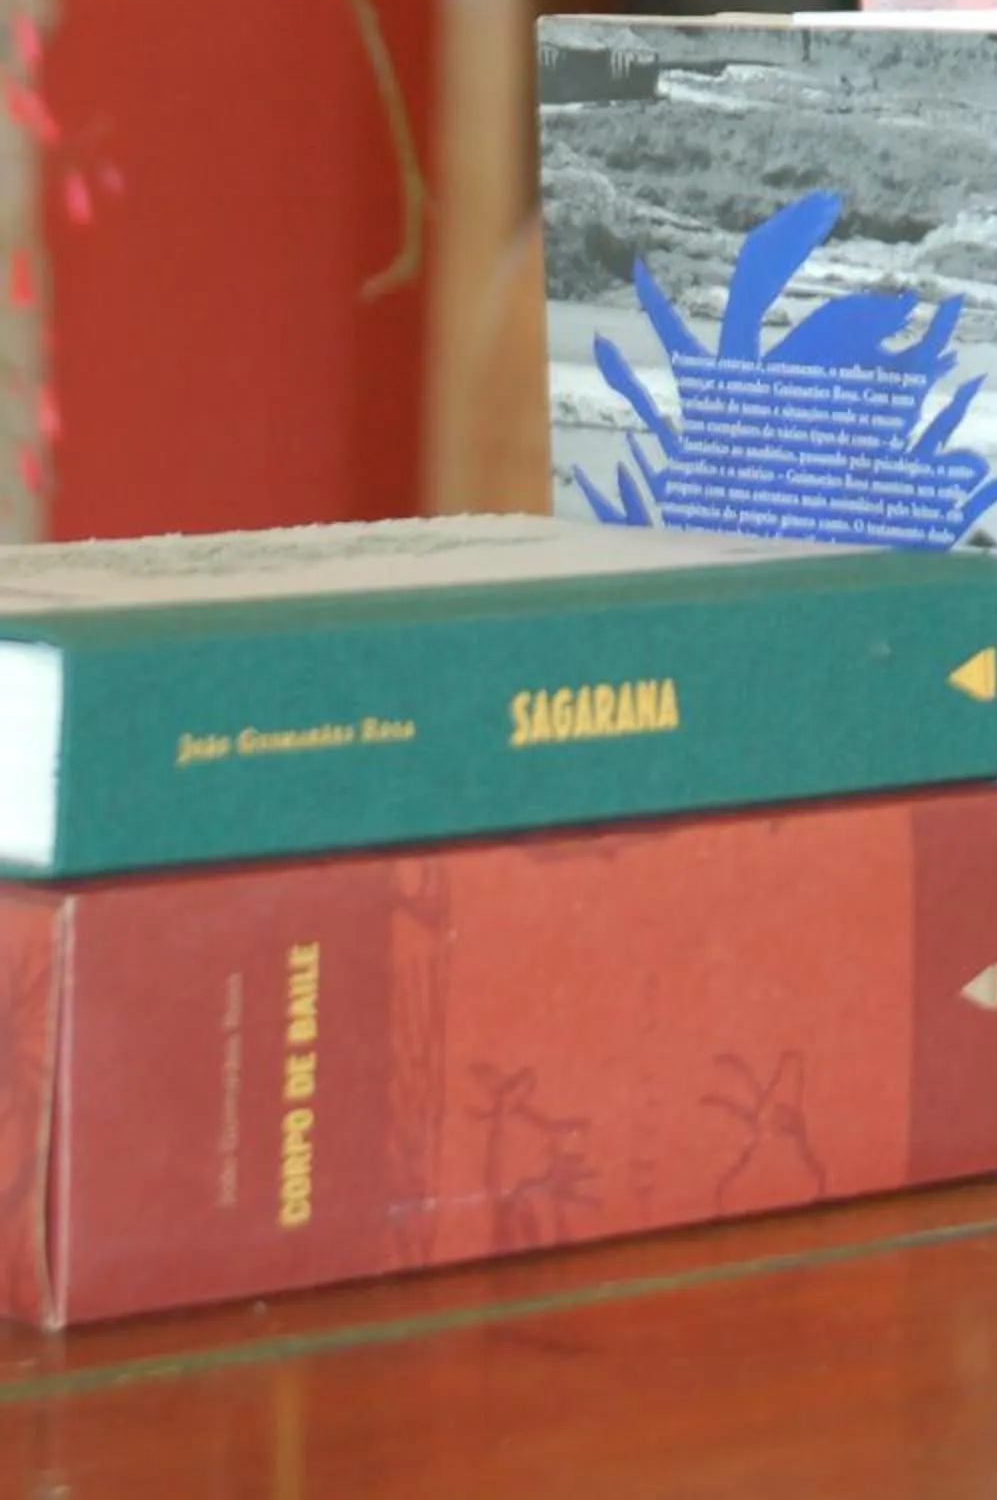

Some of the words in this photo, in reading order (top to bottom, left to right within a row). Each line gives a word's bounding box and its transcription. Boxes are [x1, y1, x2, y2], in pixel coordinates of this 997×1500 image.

[509, 677, 680, 749] SAGARANA
[287, 941, 320, 1044] BAILE
[283, 1052, 317, 1100] DE
[278, 1107, 315, 1229] CORPO
